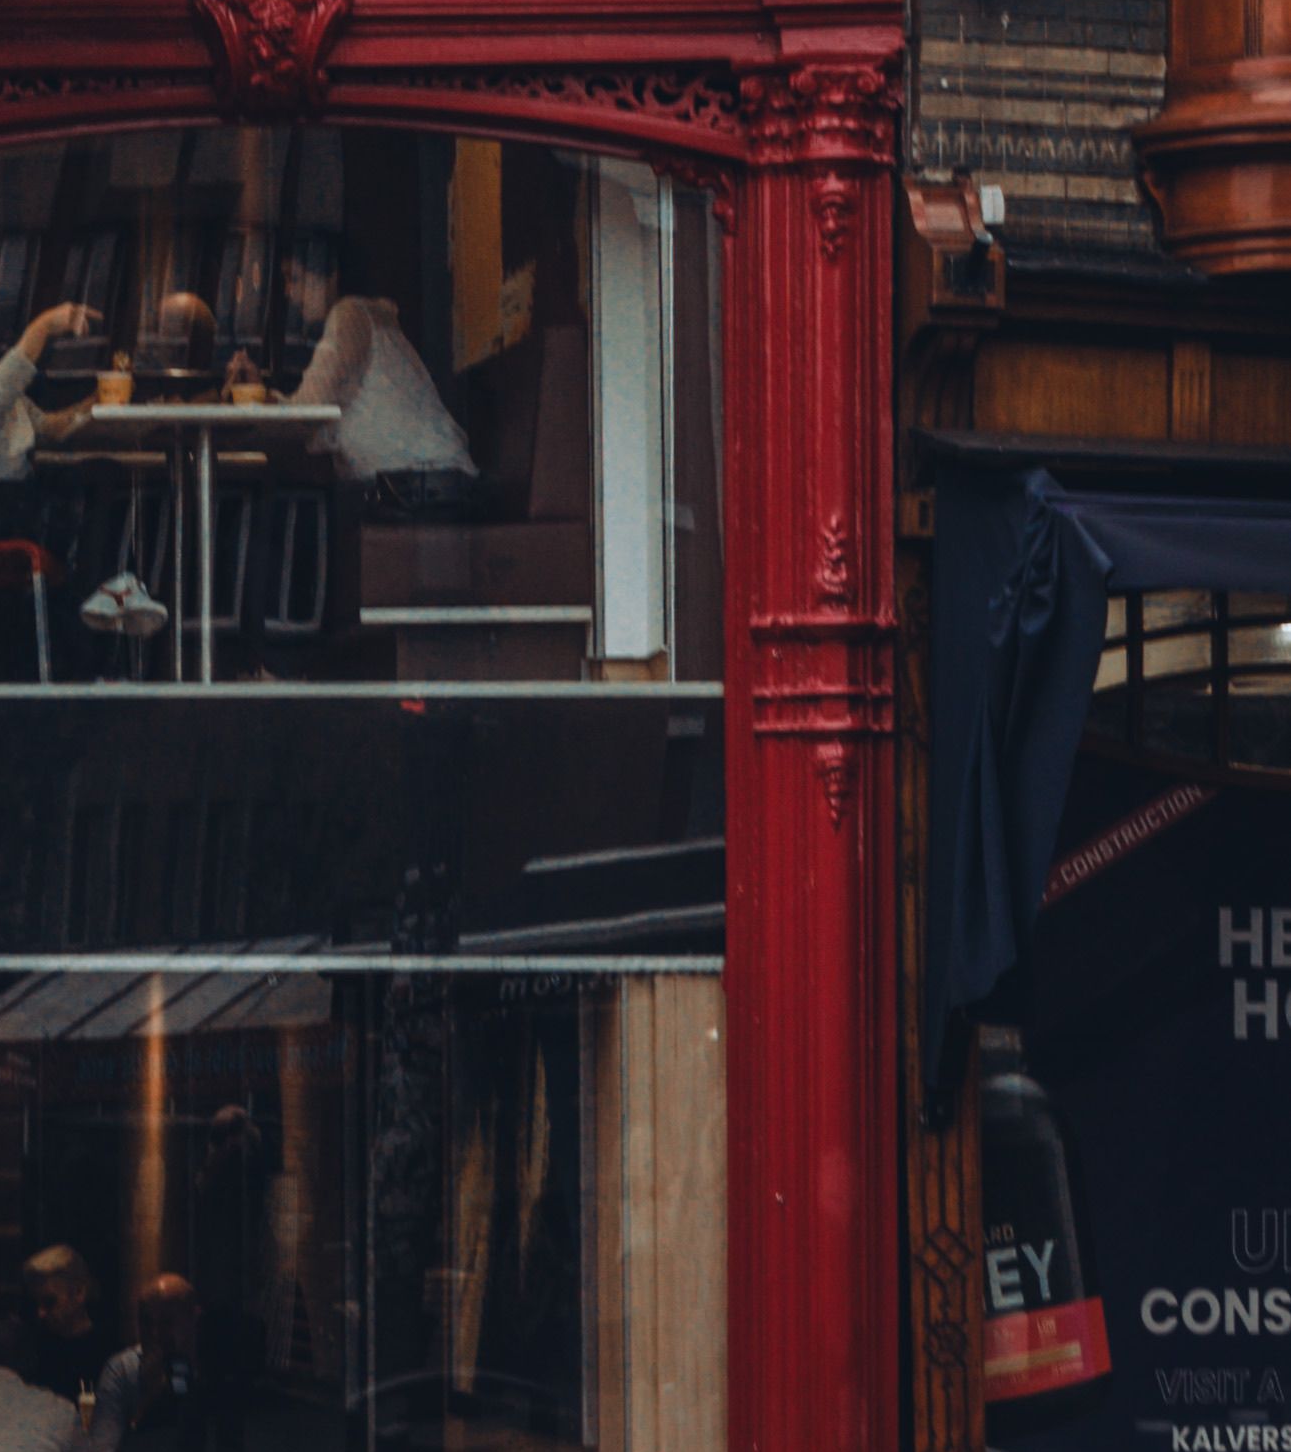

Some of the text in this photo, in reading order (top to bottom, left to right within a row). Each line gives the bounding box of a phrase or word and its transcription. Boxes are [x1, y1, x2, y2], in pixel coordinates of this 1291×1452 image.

[1059, 783, 1204, 887] CONSTRUCTION
[1232, 978, 1291, 1041] H
[1231, 1207, 1291, 1275] U
[1140, 1287, 1291, 1336] CONS
[1154, 1365, 1287, 1407] VISIT A
